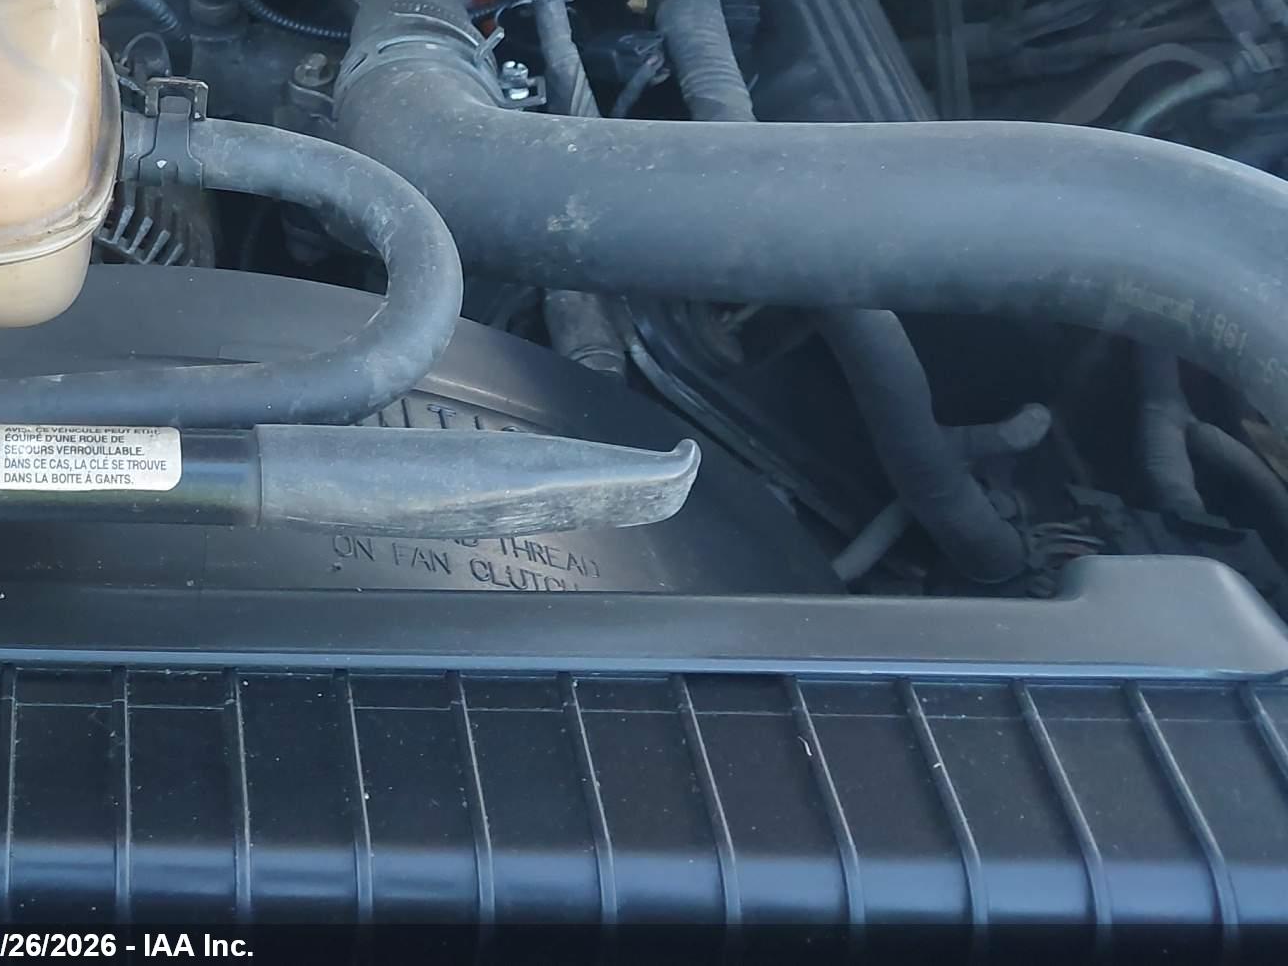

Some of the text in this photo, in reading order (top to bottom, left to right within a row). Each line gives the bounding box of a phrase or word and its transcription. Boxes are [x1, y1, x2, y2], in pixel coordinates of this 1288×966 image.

[45, 435, 76, 443] D'UNE
[79, 435, 108, 443] ROUE
[111, 436, 125, 444] DE
[4, 445, 145, 456] SECOURS VERROUILLABLE.
[4, 457, 167, 471] DANS CE CAS, LA CLÉ SE TROUVE
[4, 472, 32, 483] DANS
[35, 473, 48, 483] LA
[95, 474, 134, 485] GANTS.
[331, 534, 375, 561] ON
[391, 542, 453, 576] FAN
[498, 537, 601, 578] THREAD
